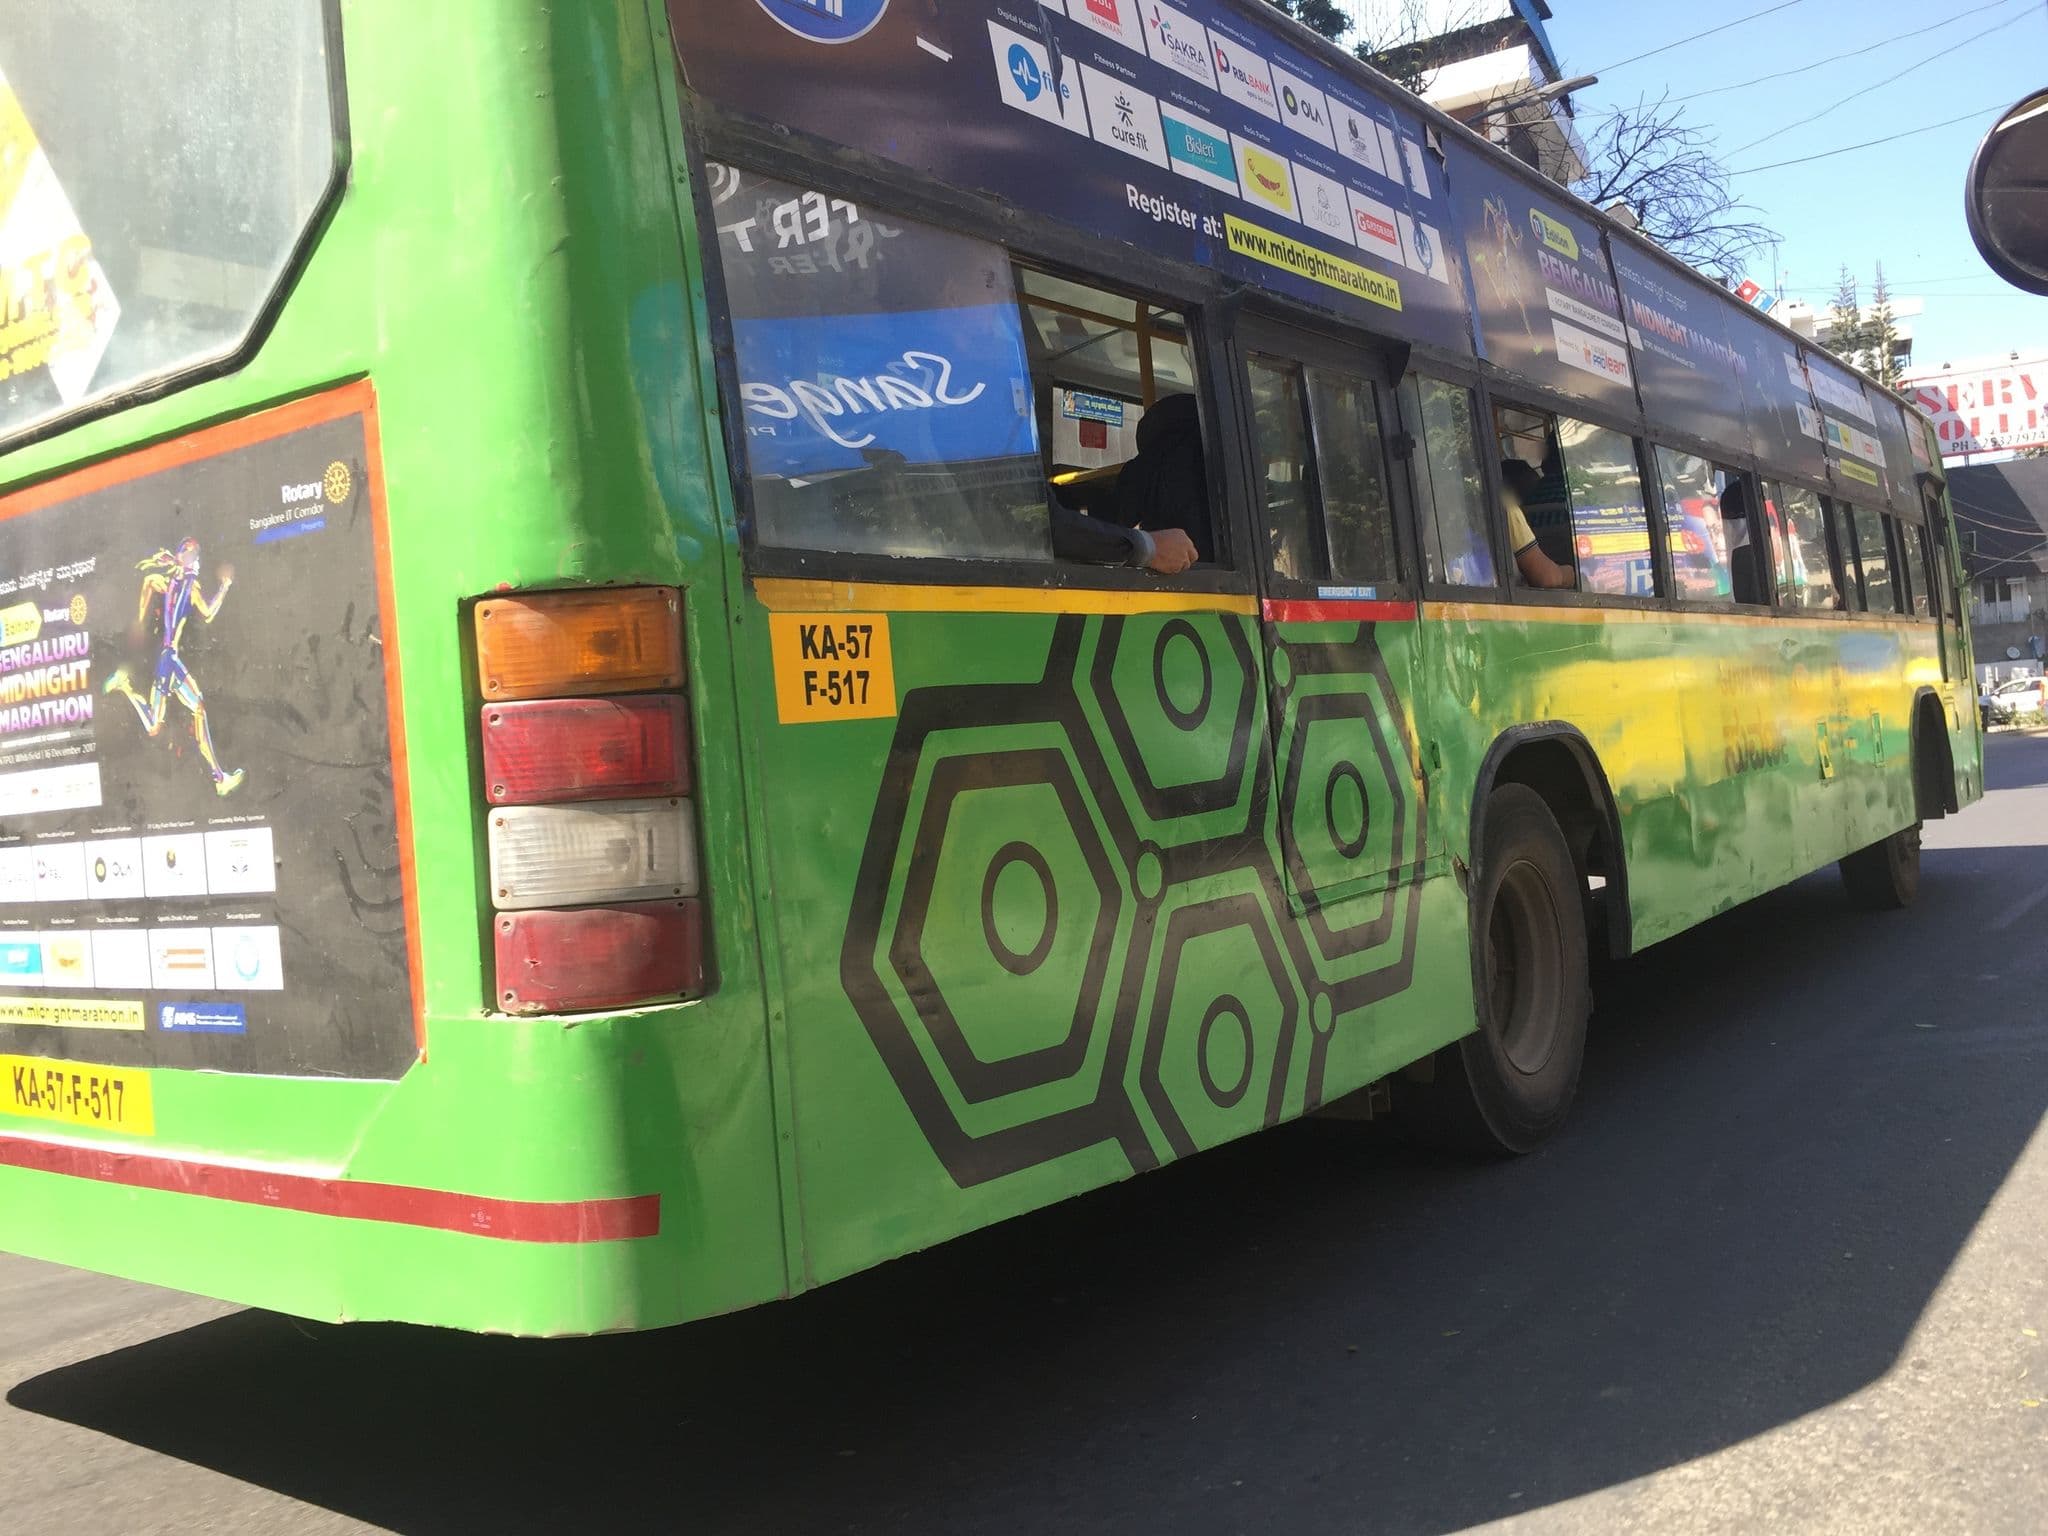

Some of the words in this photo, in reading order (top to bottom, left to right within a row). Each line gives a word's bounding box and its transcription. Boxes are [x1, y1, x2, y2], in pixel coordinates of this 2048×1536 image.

[1018, 17, 1039, 33] Health
[1166, 33, 1207, 67] SAKRA
[1093, 52, 1115, 70] Fitness
[1115, 62, 1137, 79] Partner
[1041, 70, 1070, 99] fie
[1193, 99, 1211, 114] Partner
[1300, 98, 1324, 126] OLA
[1111, 125, 1149, 152] cure.fit
[1185, 133, 1215, 159] Bisleri
[1126, 183, 1197, 231] Register
[1202, 214, 1224, 240] at:
[1543, 220, 1570, 250] Edition
[1230, 225, 1399, 305] www.midnightmarathon.in
[1631, 298, 1689, 349] MIDNIGHT
[281, 481, 323, 504] Rotary
[249, 512, 286, 530] Bangalore
[294, 503, 325, 519] Corridor
[43, 608, 70, 623] Rotary
[800, 624, 873, 660] KA-57
[803, 669, 870, 706] F-517
[51, 744, 81, 757] December
[13, 1065, 124, 1123] KA-57-F-517
